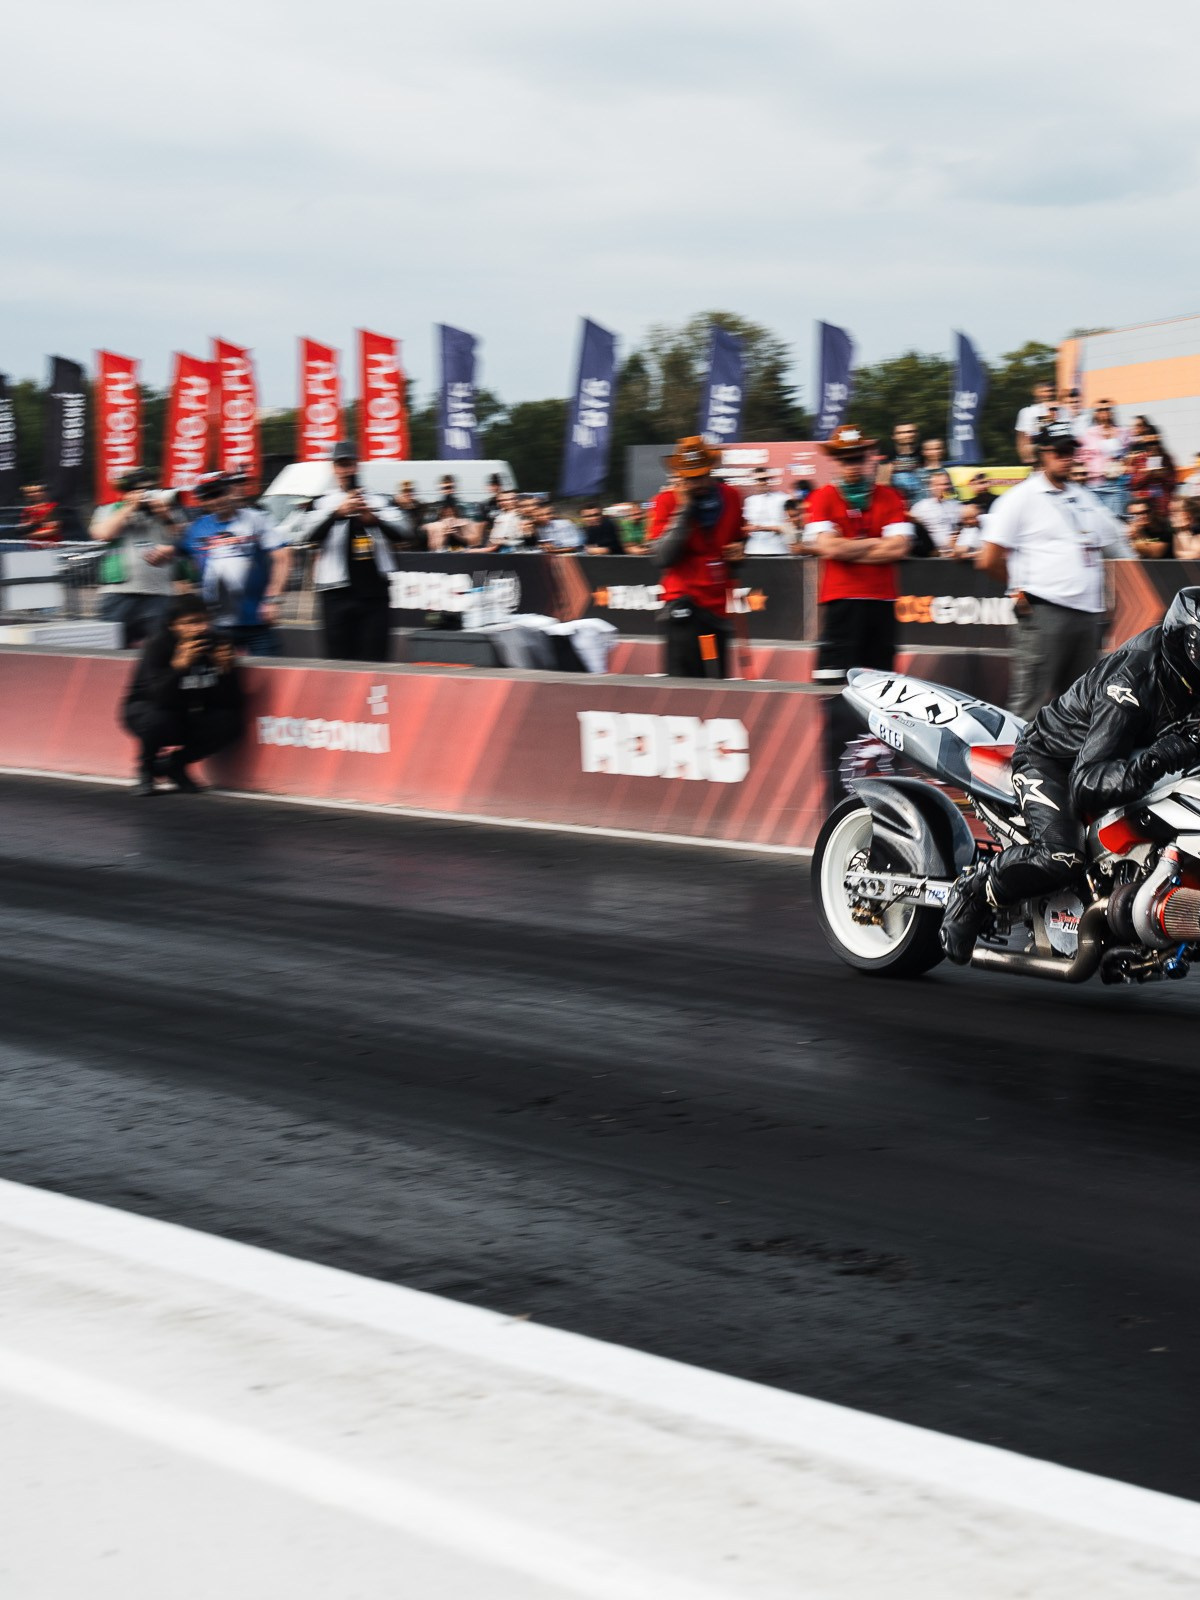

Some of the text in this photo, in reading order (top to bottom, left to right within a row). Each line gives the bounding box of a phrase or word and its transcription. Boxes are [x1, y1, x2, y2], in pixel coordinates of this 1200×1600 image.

[302, 360, 338, 460] uto.ru
[364, 353, 402, 461] uto.ru
[894, 595, 1019, 625] OSGONK
